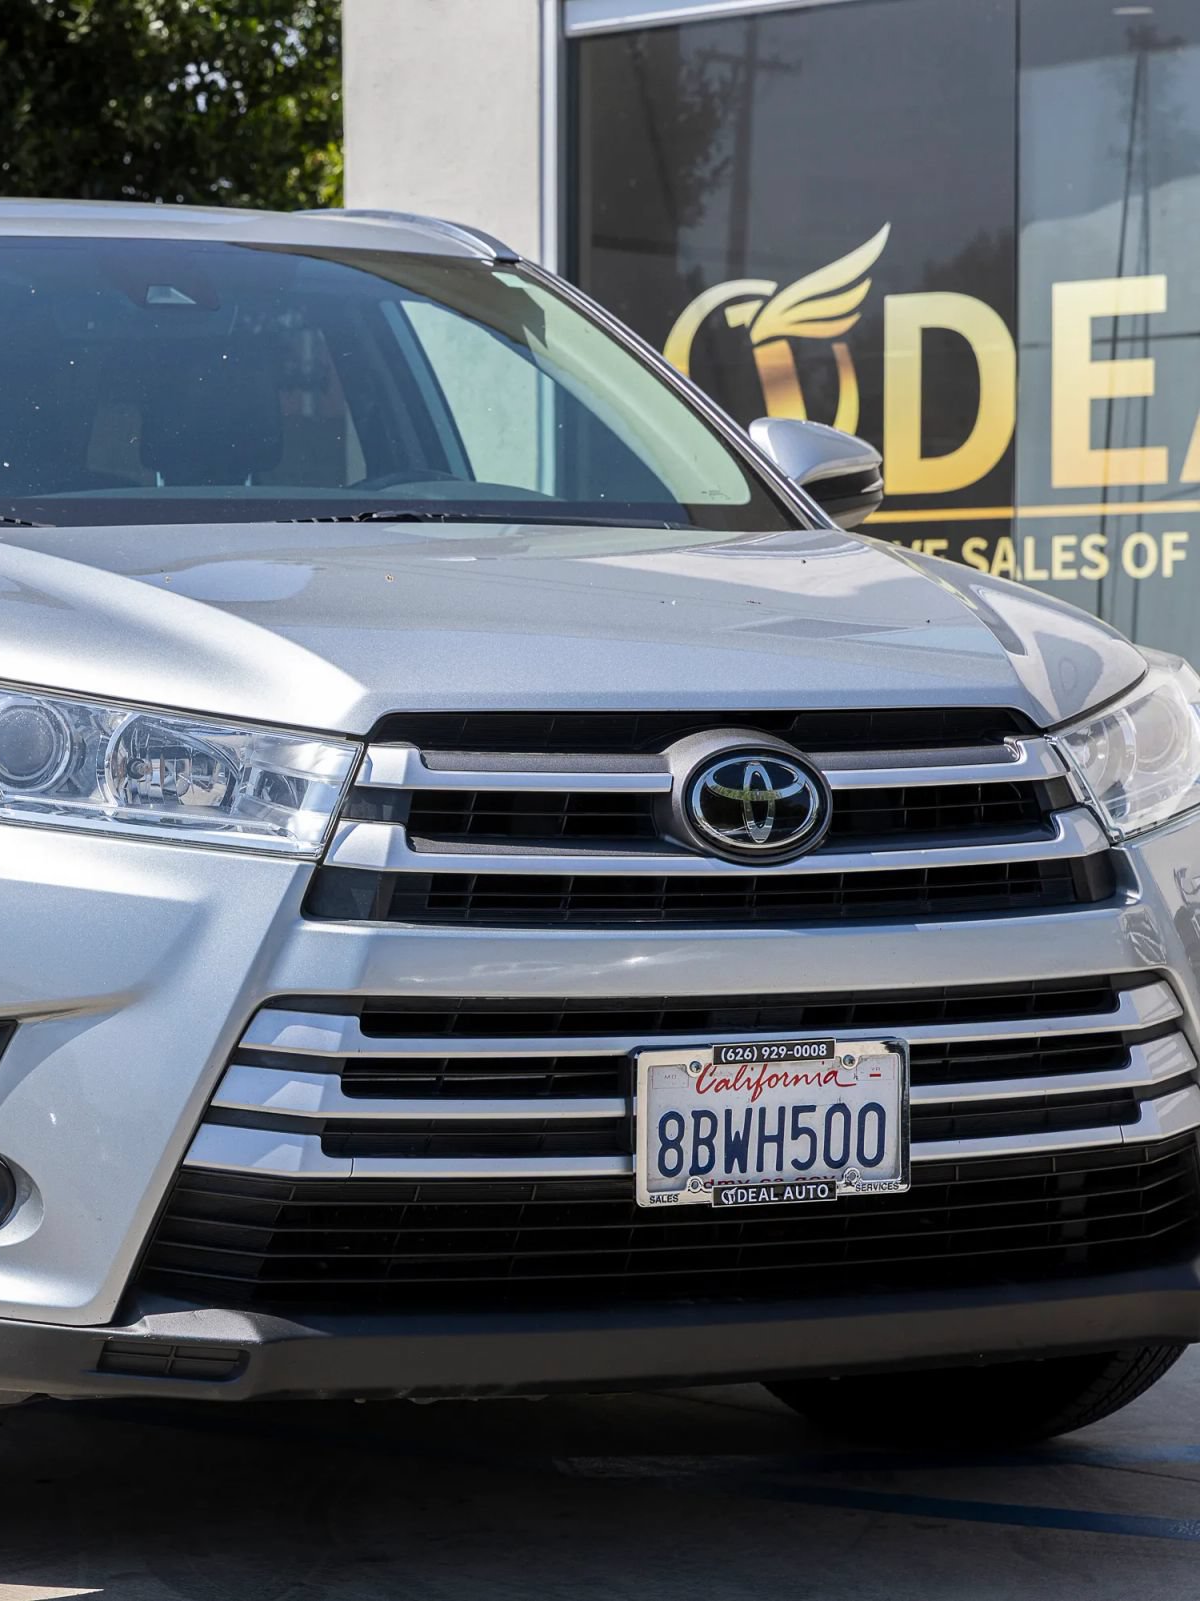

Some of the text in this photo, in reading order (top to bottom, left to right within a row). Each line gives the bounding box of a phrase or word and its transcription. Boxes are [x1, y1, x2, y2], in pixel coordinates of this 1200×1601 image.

[962, 533, 1109, 581] SALES
[1121, 531, 1189, 580] OF
[721, 1044, 827, 1063] (626) 929-0008
[695, 1061, 857, 1103] California
[657, 1102, 887, 1178] 8BWH500
[783, 1184, 829, 1200] AUTO
[855, 1182, 900, 1192] SERVICES
[649, 1193, 679, 1204] SALES
